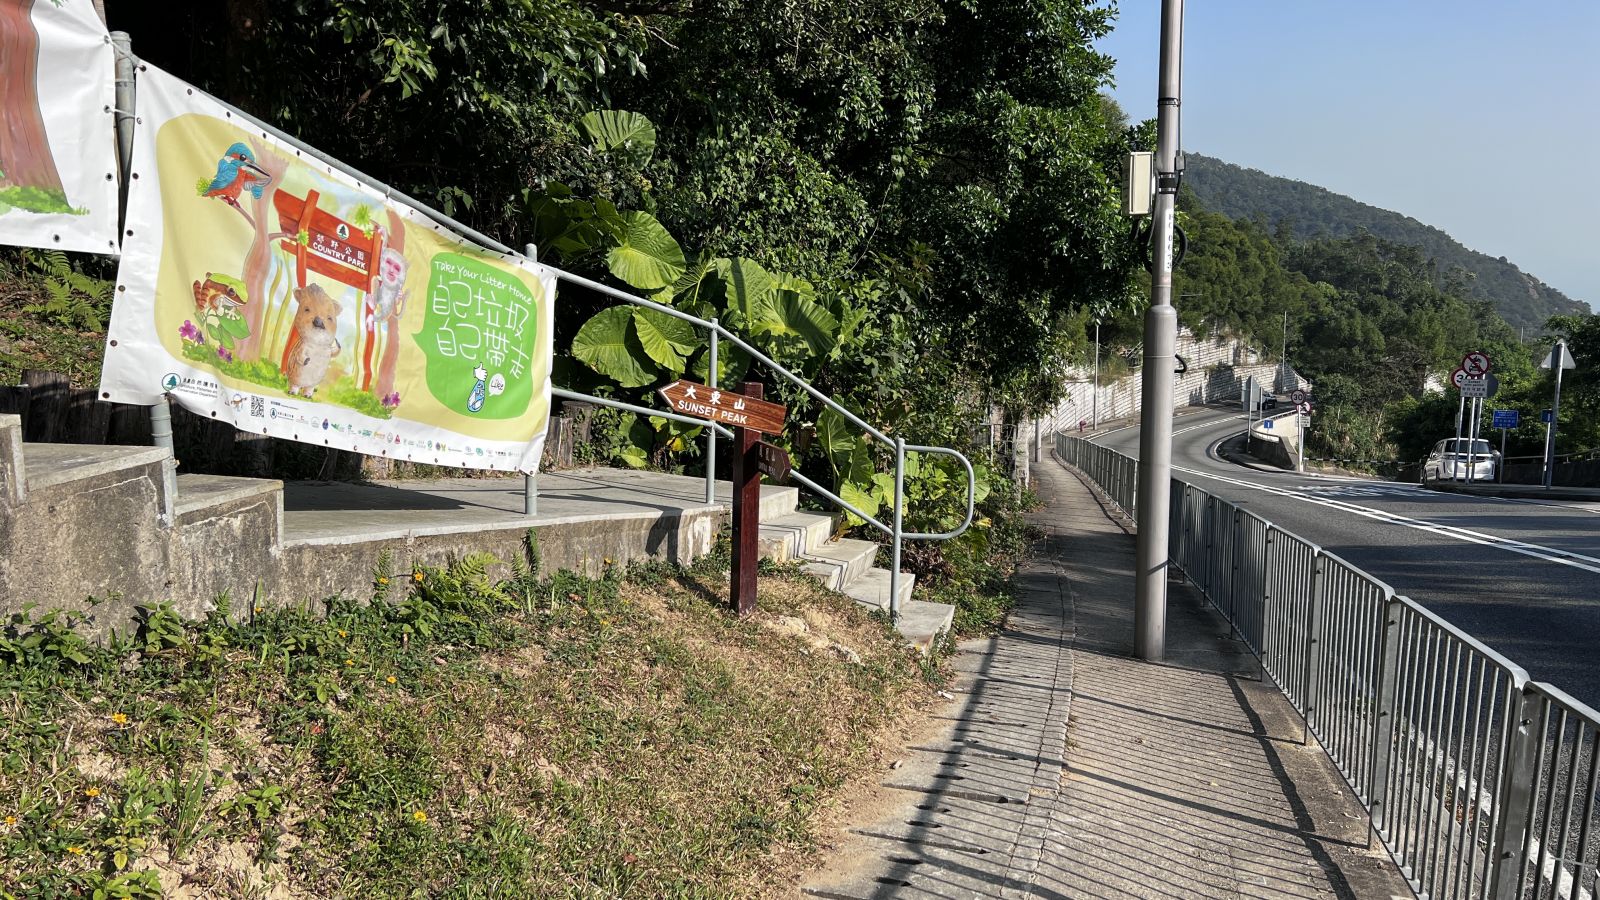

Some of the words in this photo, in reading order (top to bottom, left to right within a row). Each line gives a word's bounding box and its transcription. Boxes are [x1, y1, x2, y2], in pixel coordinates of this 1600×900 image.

[312, 241, 346, 261] COUNTRY
[347, 256, 366, 270] PARK
[434, 261, 455, 274] Take
[457, 266, 478, 280] Your
[480, 272, 506, 290] Litter
[508, 284, 532, 305] Home
[433, 275, 529, 340] 自己垃圾
[437, 317, 529, 380] 自己帶走
[678, 400, 717, 417] SUNSET
[721, 410, 748, 425] PEAK
[684, 385, 746, 411] 大東山
